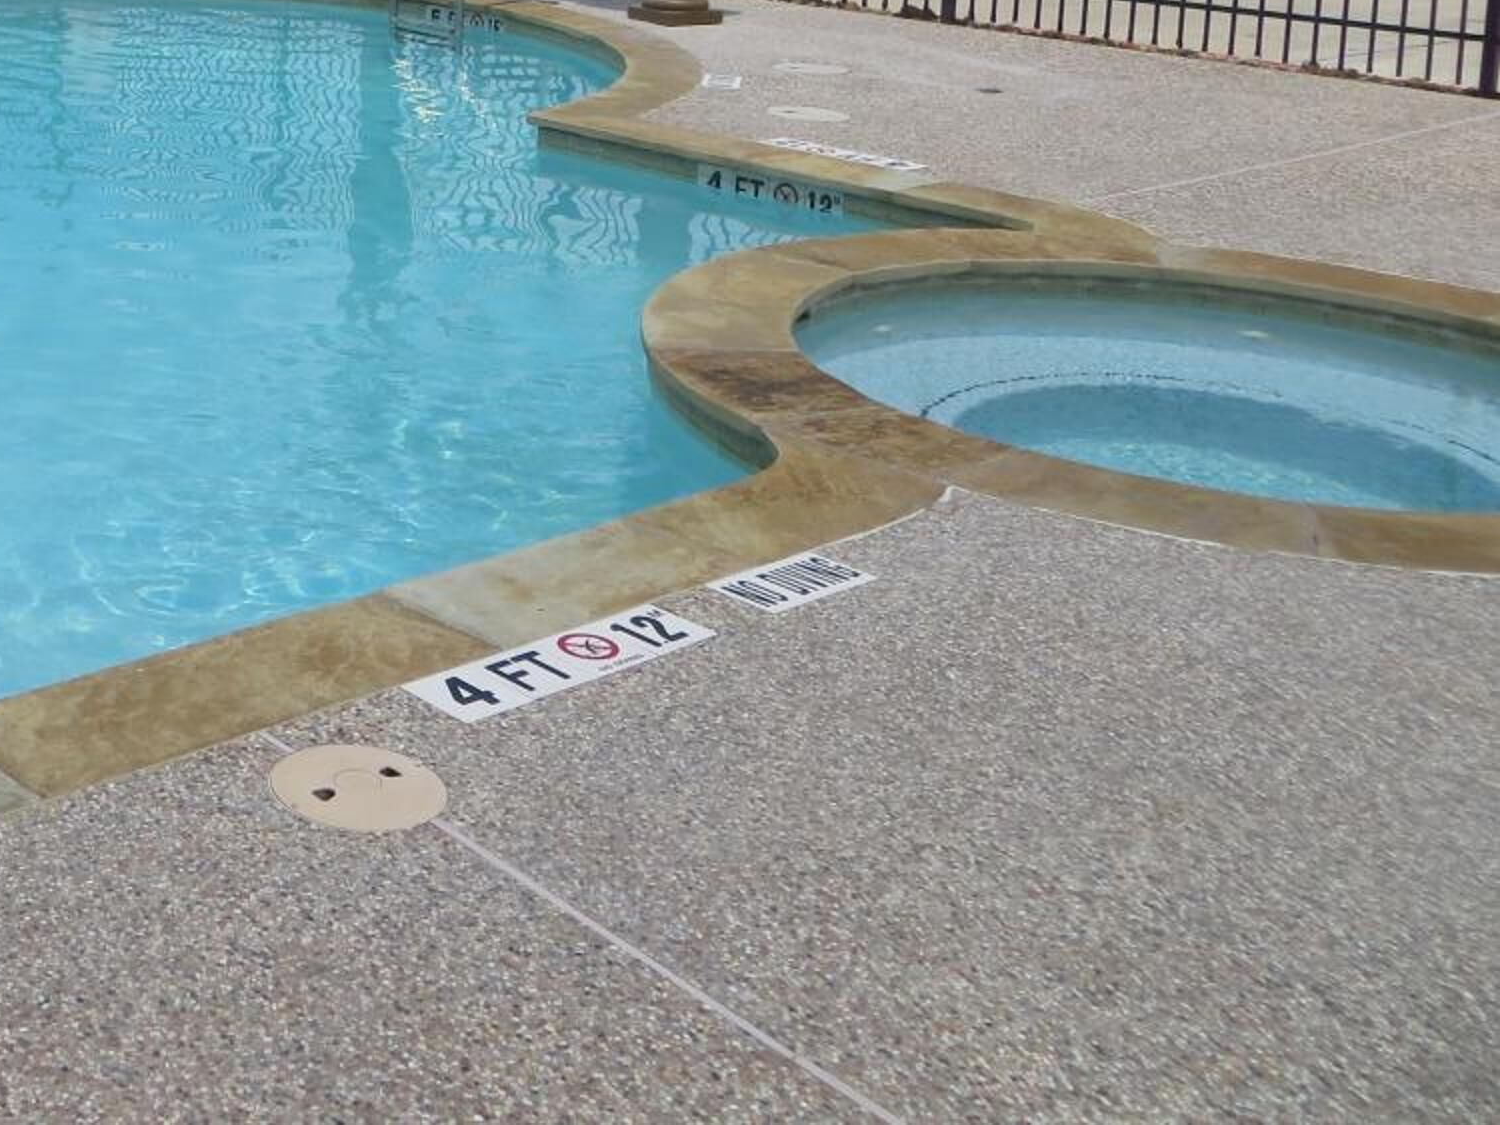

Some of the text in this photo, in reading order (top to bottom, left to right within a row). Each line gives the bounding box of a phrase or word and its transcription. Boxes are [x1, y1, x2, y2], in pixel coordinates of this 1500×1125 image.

[734, 175, 765, 199] FT
[720, 557, 861, 608] NO DIVING
[444, 675, 501, 706] 4
[484, 650, 572, 692] FT
